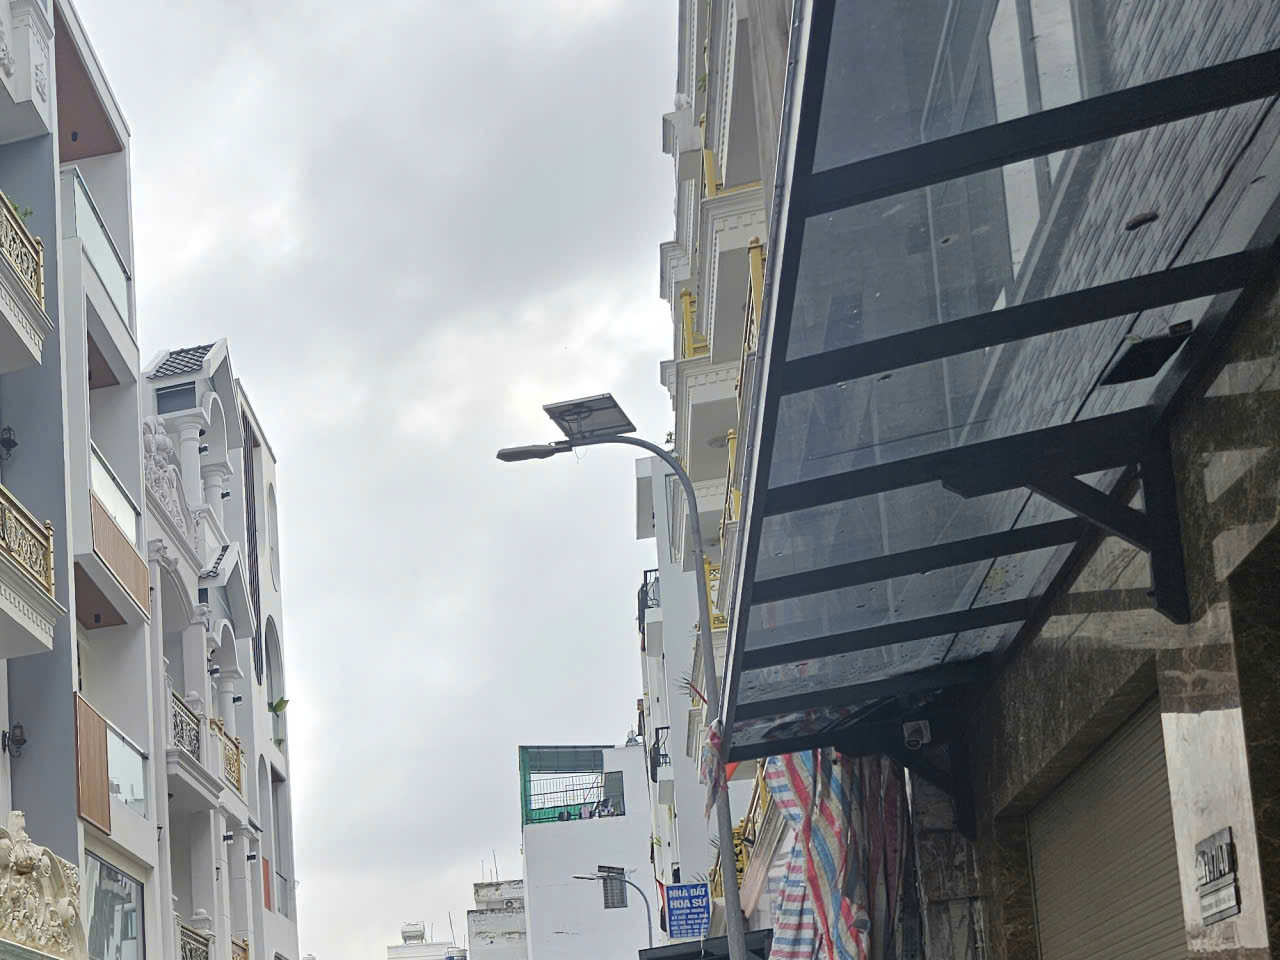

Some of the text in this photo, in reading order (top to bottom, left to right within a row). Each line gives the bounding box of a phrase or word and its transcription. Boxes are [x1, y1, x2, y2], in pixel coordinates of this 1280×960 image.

[669, 885, 706, 898] NHÀ ĐẤT
[670, 899, 691, 909] HOA
